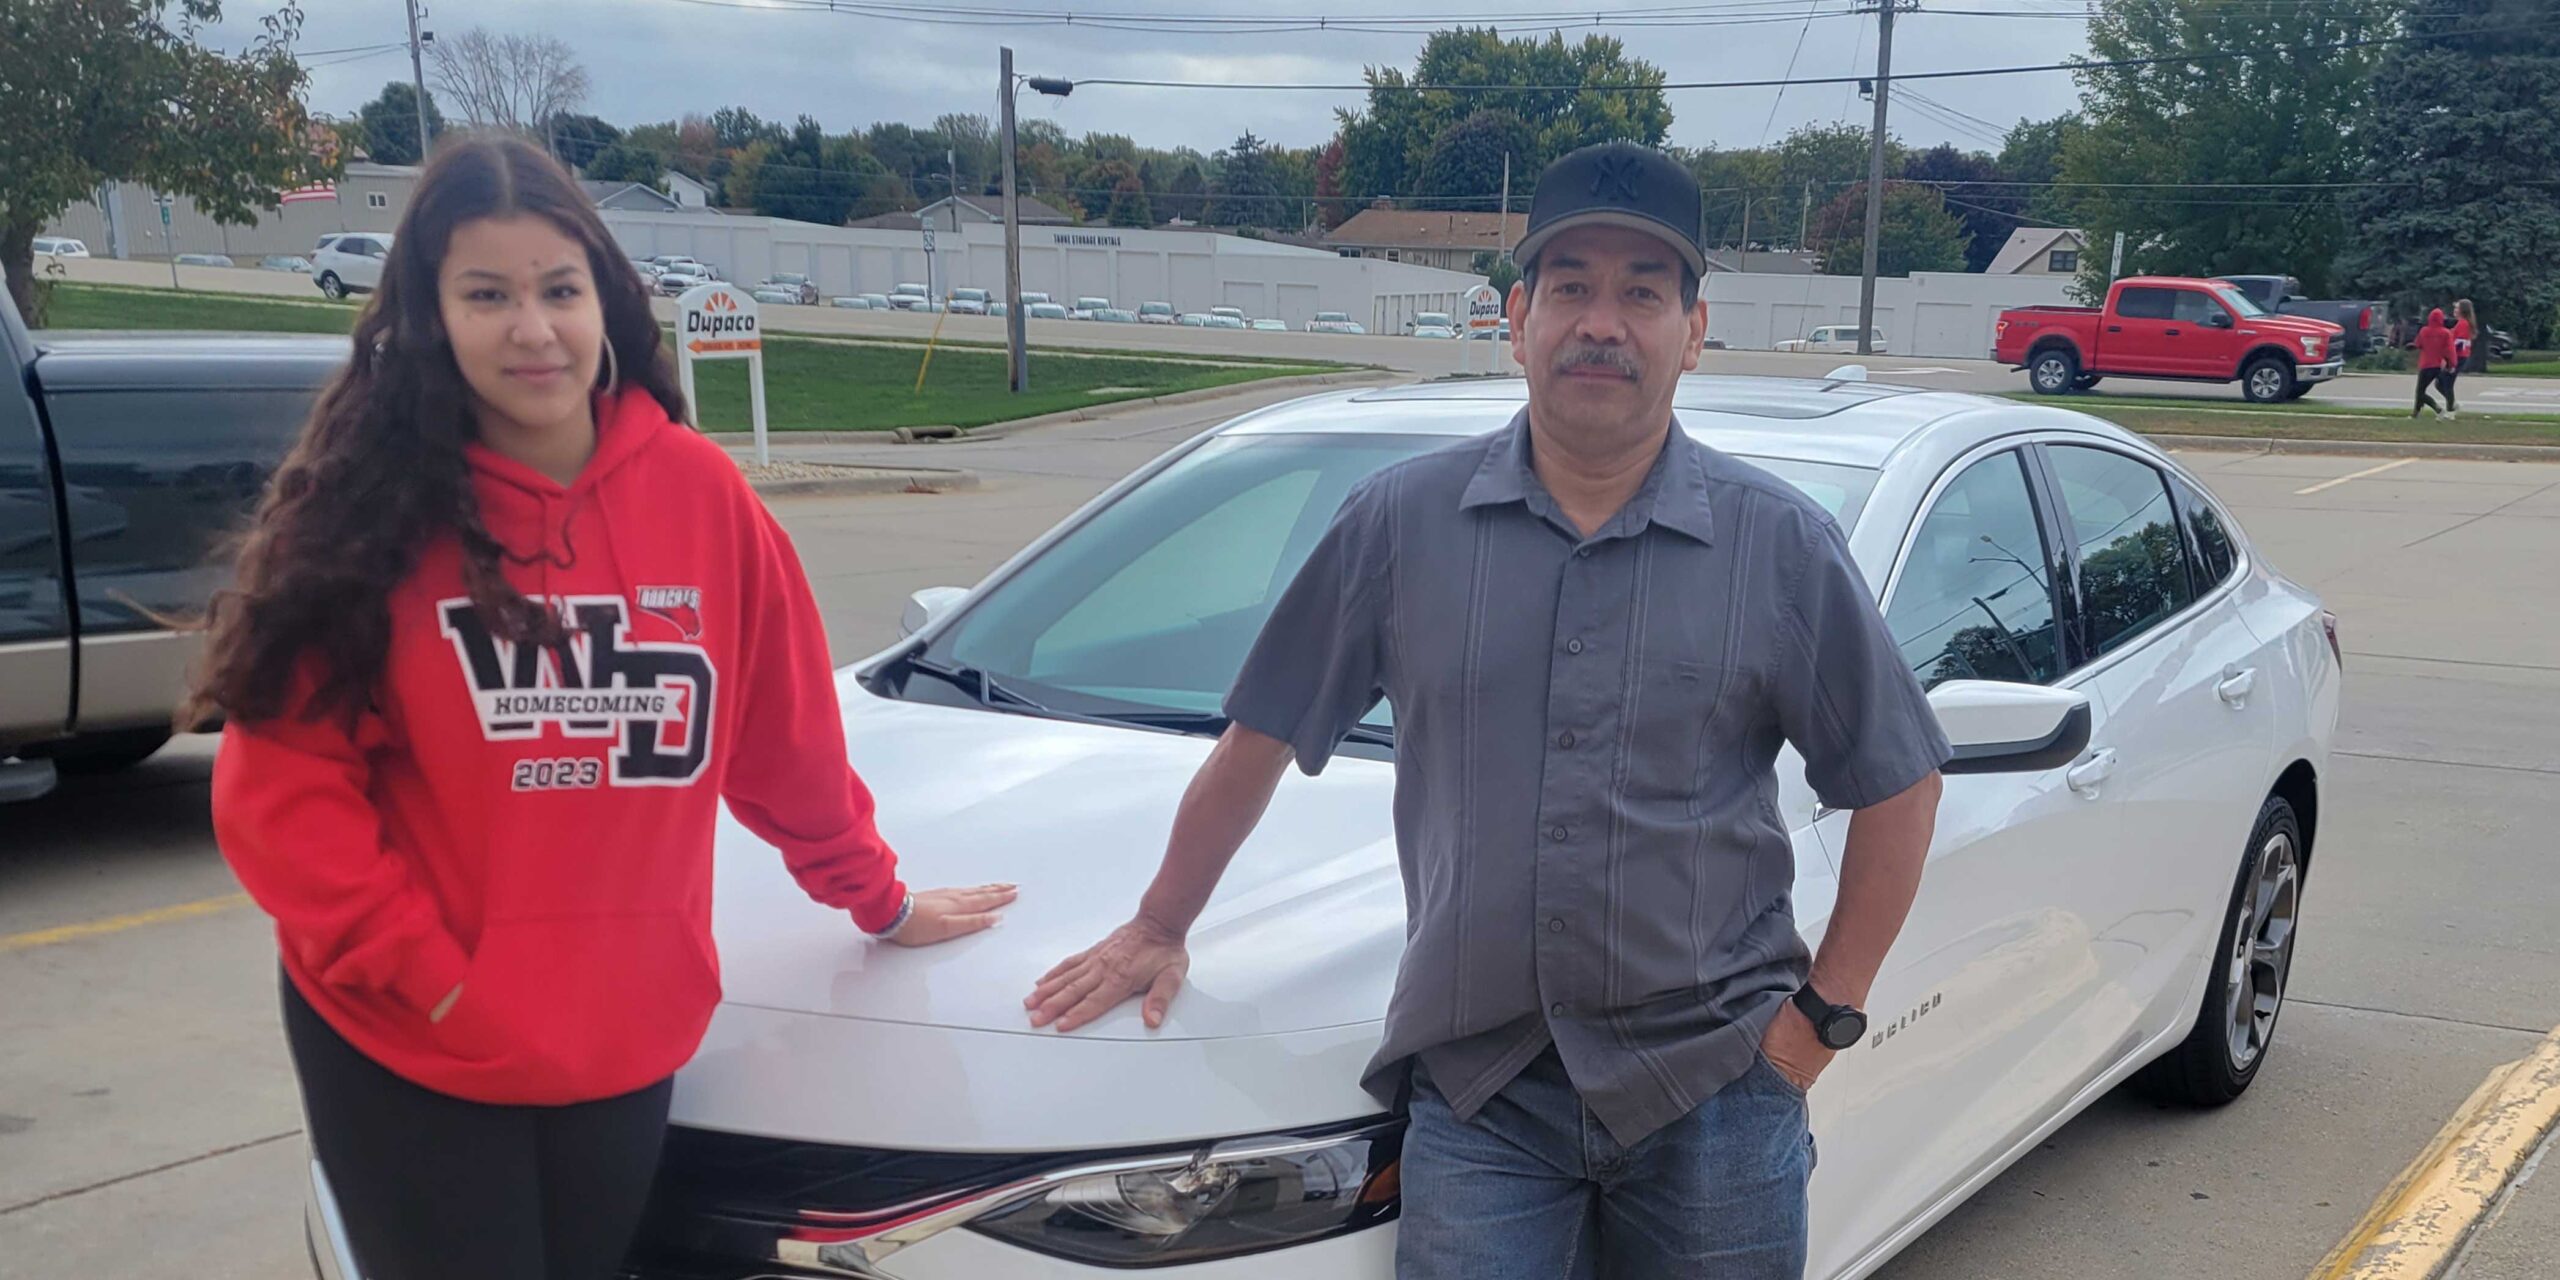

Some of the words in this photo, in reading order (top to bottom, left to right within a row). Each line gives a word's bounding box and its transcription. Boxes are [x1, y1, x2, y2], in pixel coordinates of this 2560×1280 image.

[1072, 234, 1096, 245] STORAGE
[1470, 301, 1499, 319] Dupaco
[687, 311, 755, 338] Dupaco
[494, 696, 665, 715] HOMECOMING
[512, 759, 601, 791] 2023
